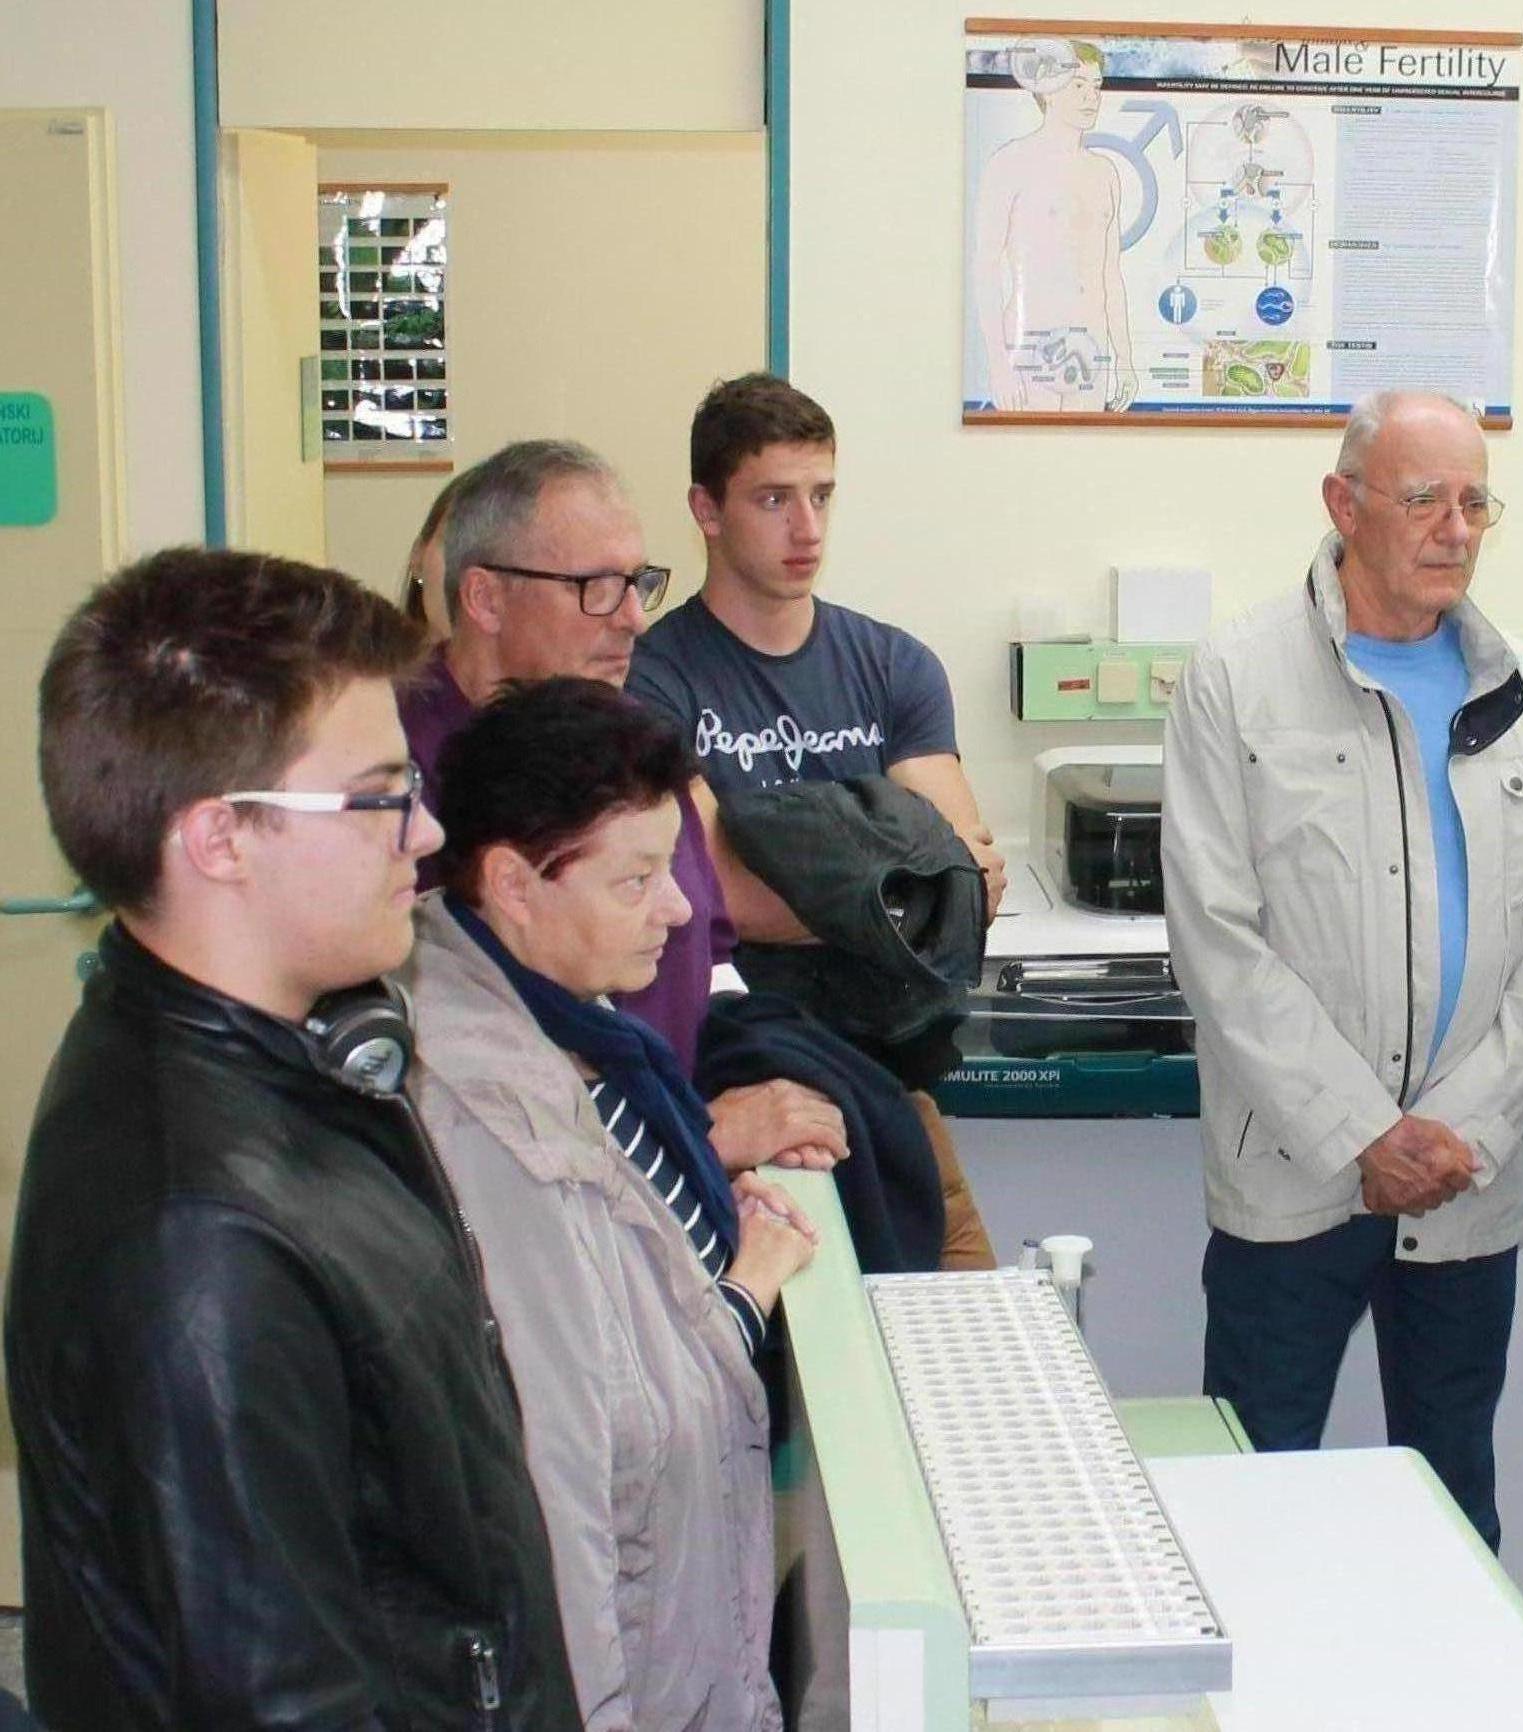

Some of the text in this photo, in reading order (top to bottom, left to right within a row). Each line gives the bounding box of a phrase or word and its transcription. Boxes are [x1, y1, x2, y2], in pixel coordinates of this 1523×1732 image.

[1274, 42, 1506, 87] Male Fertility
[695, 707, 886, 773] Pepe Jeans
[943, 1069, 999, 1082] MULITE
[1002, 1069, 1037, 1082] 2000
